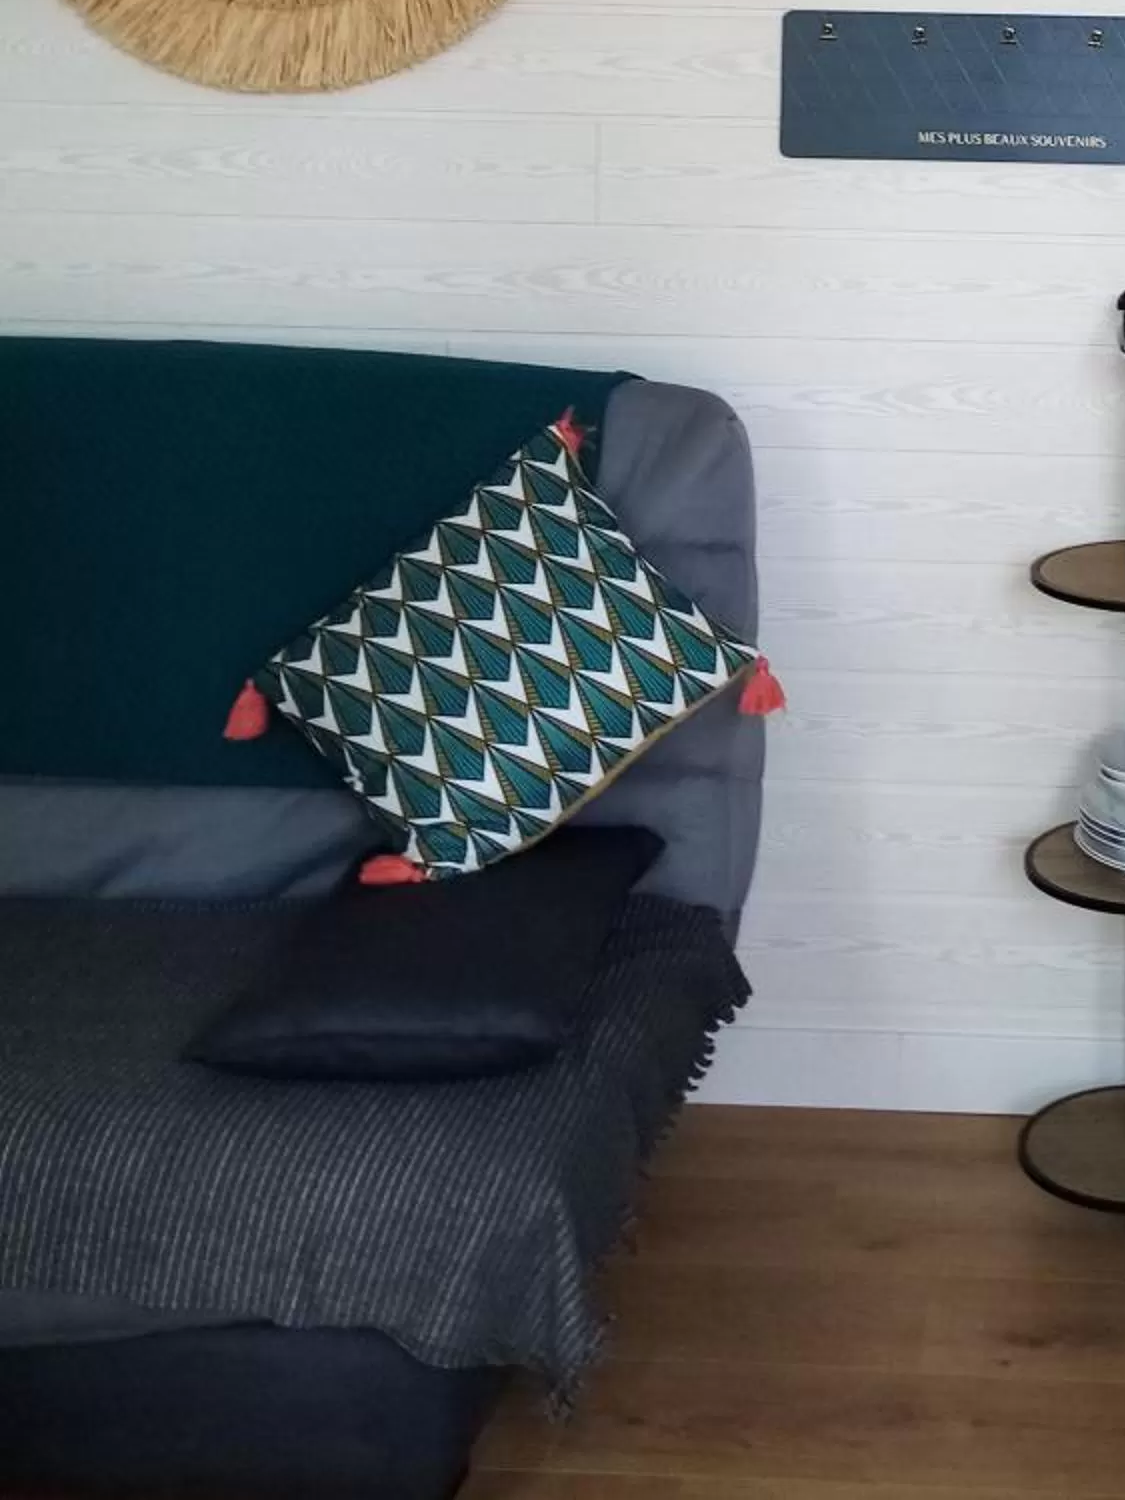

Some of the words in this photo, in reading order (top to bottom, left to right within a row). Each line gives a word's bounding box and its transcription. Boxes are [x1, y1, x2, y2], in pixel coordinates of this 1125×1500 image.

[917, 131, 947, 144] MES
[948, 132, 982, 145] PLUS
[983, 133, 1029, 147] BEAUX
[1030, 134, 1107, 149] SOUVENIRS
